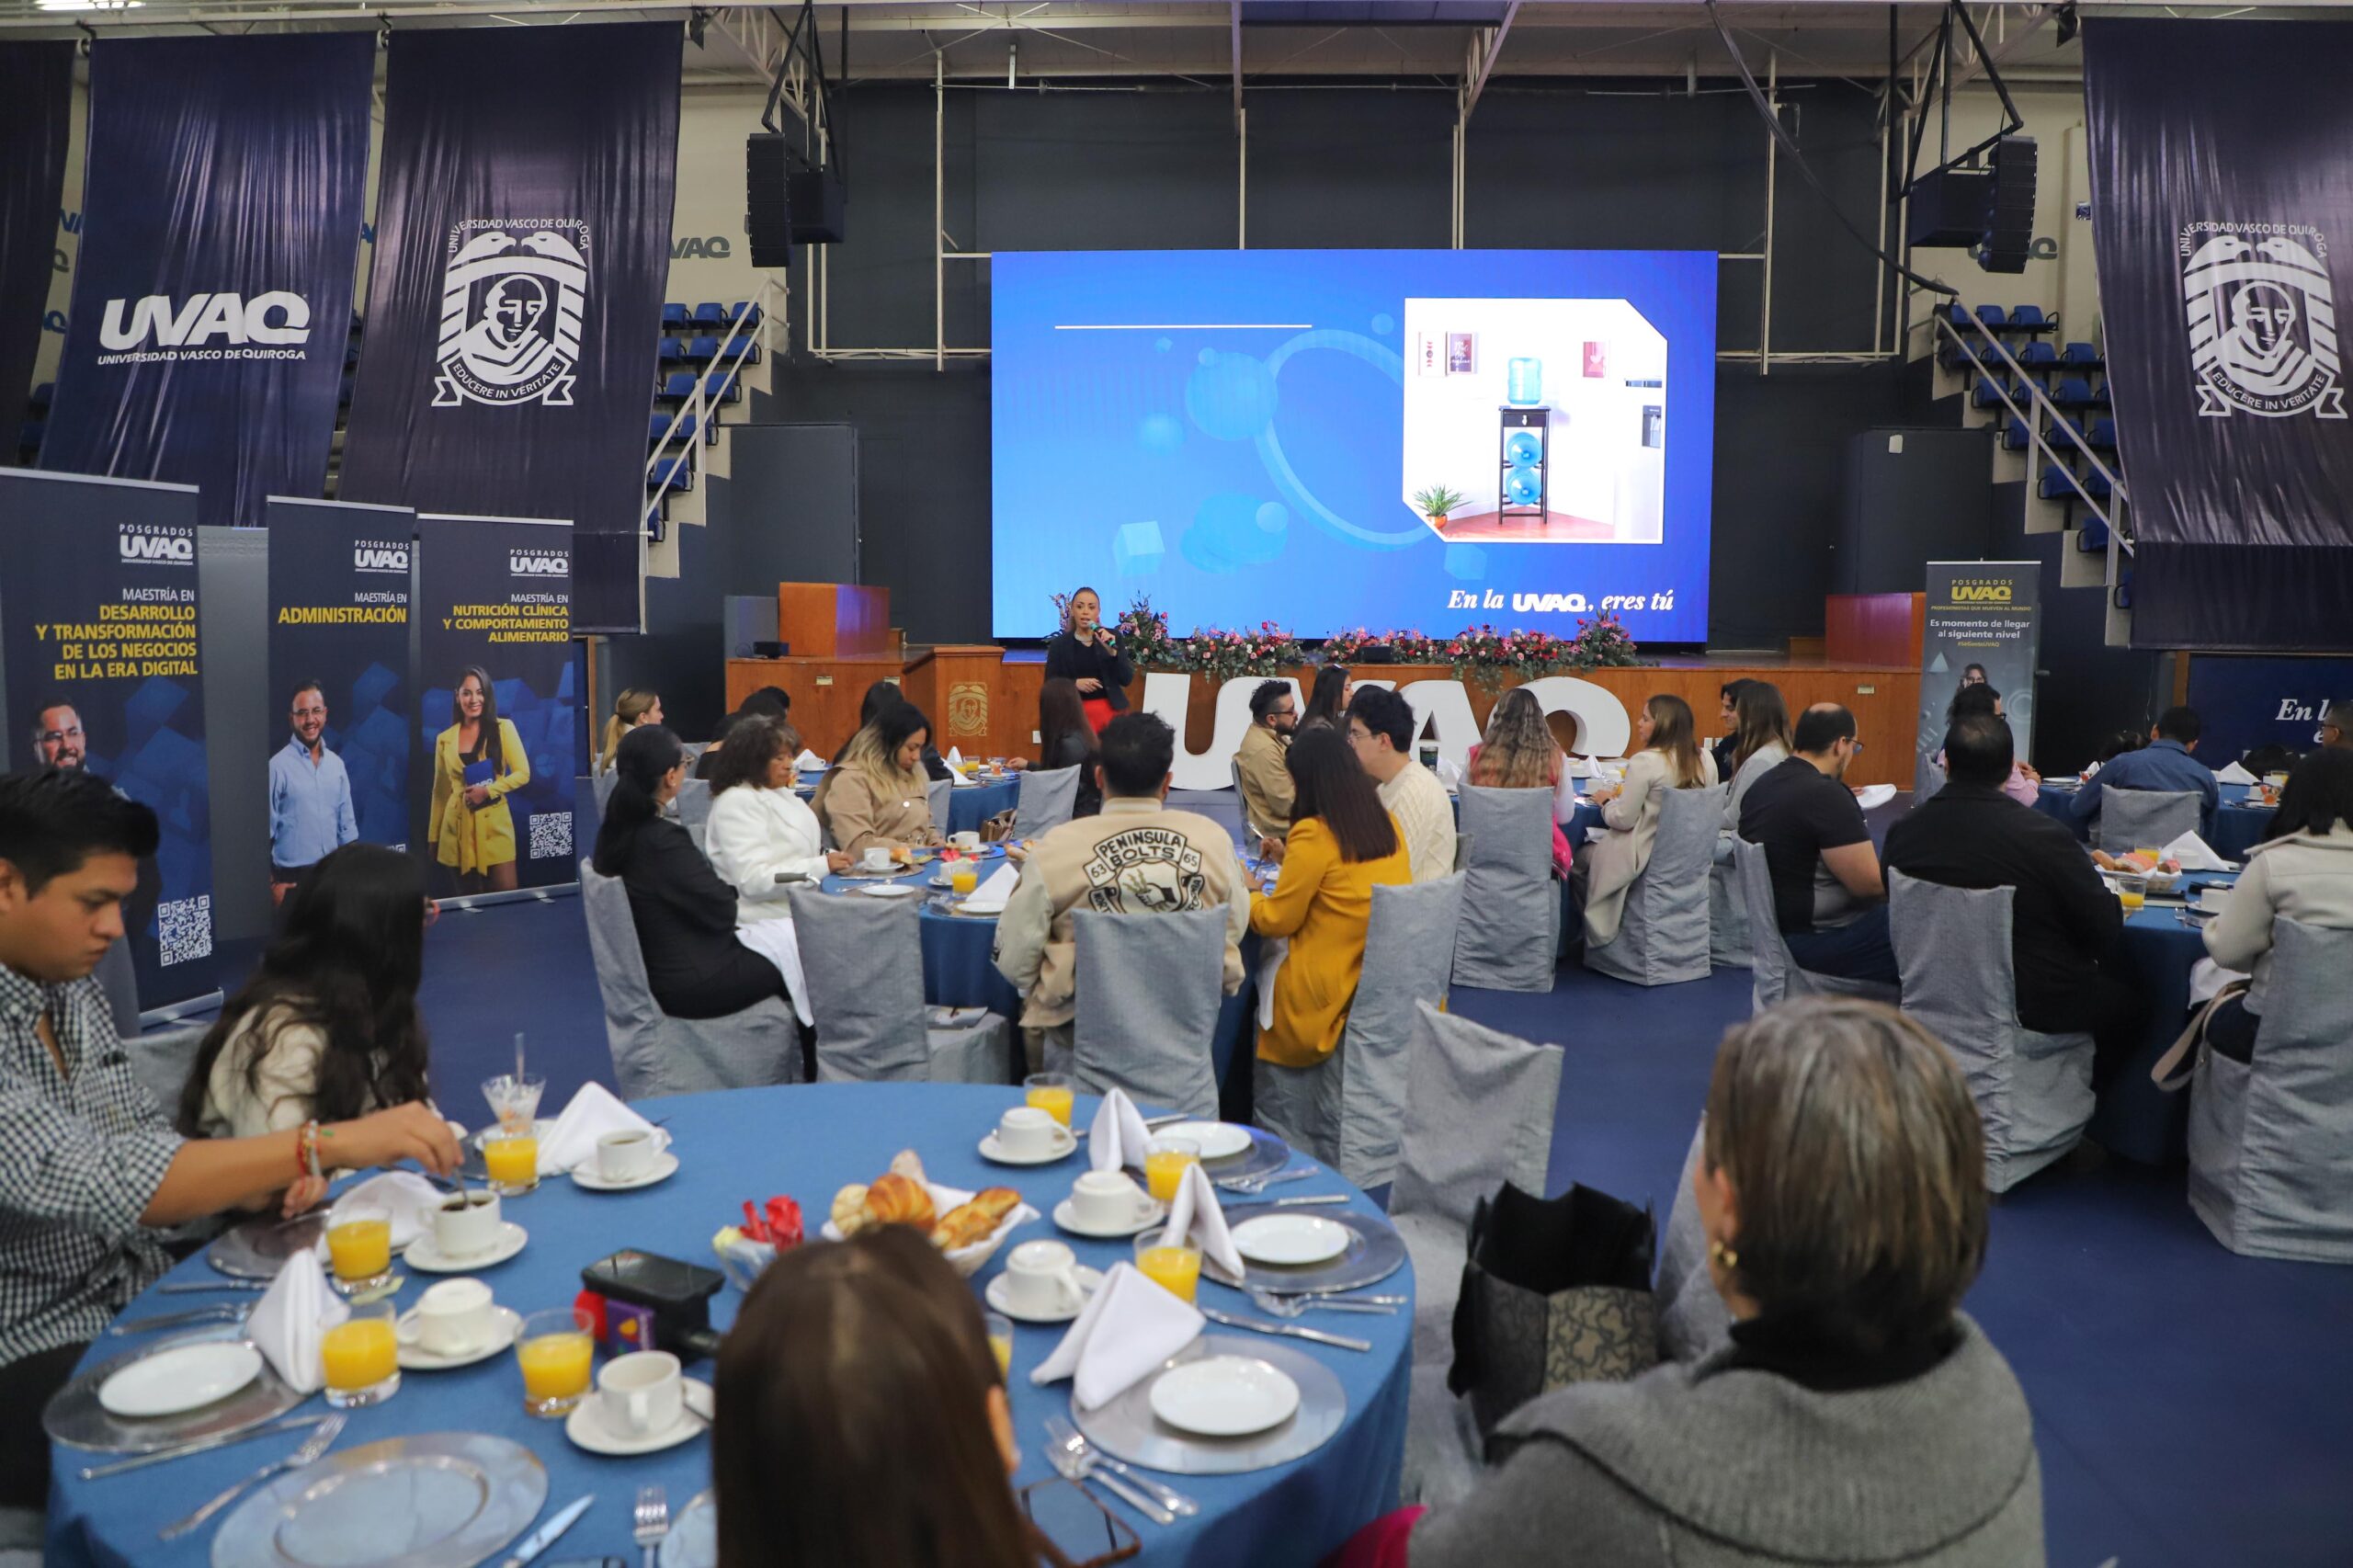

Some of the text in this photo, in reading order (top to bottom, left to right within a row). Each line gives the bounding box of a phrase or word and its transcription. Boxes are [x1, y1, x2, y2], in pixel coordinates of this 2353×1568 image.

[449, 218, 590, 253] UNIVERSIDAD VASCO DE QUIROGA
[2179, 221, 2327, 258] UNIVERSIDAD VASCO DE QUIROGA
[669, 236, 731, 259] VAQ
[99, 290, 311, 350] UVAQ
[97, 348, 306, 366] UNIVERSIDAD VASCO DE QUIROGA
[452, 362, 562, 399] EDUCERE IN VERITATE
[2212, 371, 2325, 411] EDUCERE IN VERITATE
[119, 523, 193, 537] POSGRADOS
[119, 535, 193, 560] UVAQ
[355, 540, 410, 550] POSGRADOS
[510, 549, 569, 557] POSGRADOS
[354, 549, 408, 569] UVAQ
[510, 557, 569, 574] UVAQ
[122, 586, 195, 601] MAESTRÍA EN
[355, 591, 407, 603] MAESTRÍA EN
[511, 593, 569, 604] MAESTRÍA EN
[1447, 590, 1477, 609] En
[1483, 588, 1504, 609] la
[1601, 595, 1646, 611] eres
[1651, 589, 1674, 611] tú
[1951, 585, 2012, 601] UVAQ
[99, 605, 196, 620] DESARROLLO
[278, 604, 406, 624] ADMINISTRACIÓN
[452, 603, 569, 617] NUTRICIÓN CLÍNICA
[34, 621, 196, 641] Y TRANSFORMACIÓN
[442, 619, 569, 630] Y COMPORTAMIENTO
[1930, 619, 2030, 630] Es momento de llegar
[488, 631, 569, 642] ALIMENTARIO
[1938, 630, 1946, 638] al
[1948, 630, 1993, 640] siguiente
[62, 642, 197, 660] DE LOS NEGOCIOS
[54, 660, 199, 680] EN LA ERA DIGITAL
[2275, 699, 2331, 722] En l
[1098, 831, 1181, 858] PENINSULA
[1109, 846, 1175, 867] BOLTS
[1183, 853, 1198, 867] 65
[1090, 863, 1107, 879] 63
